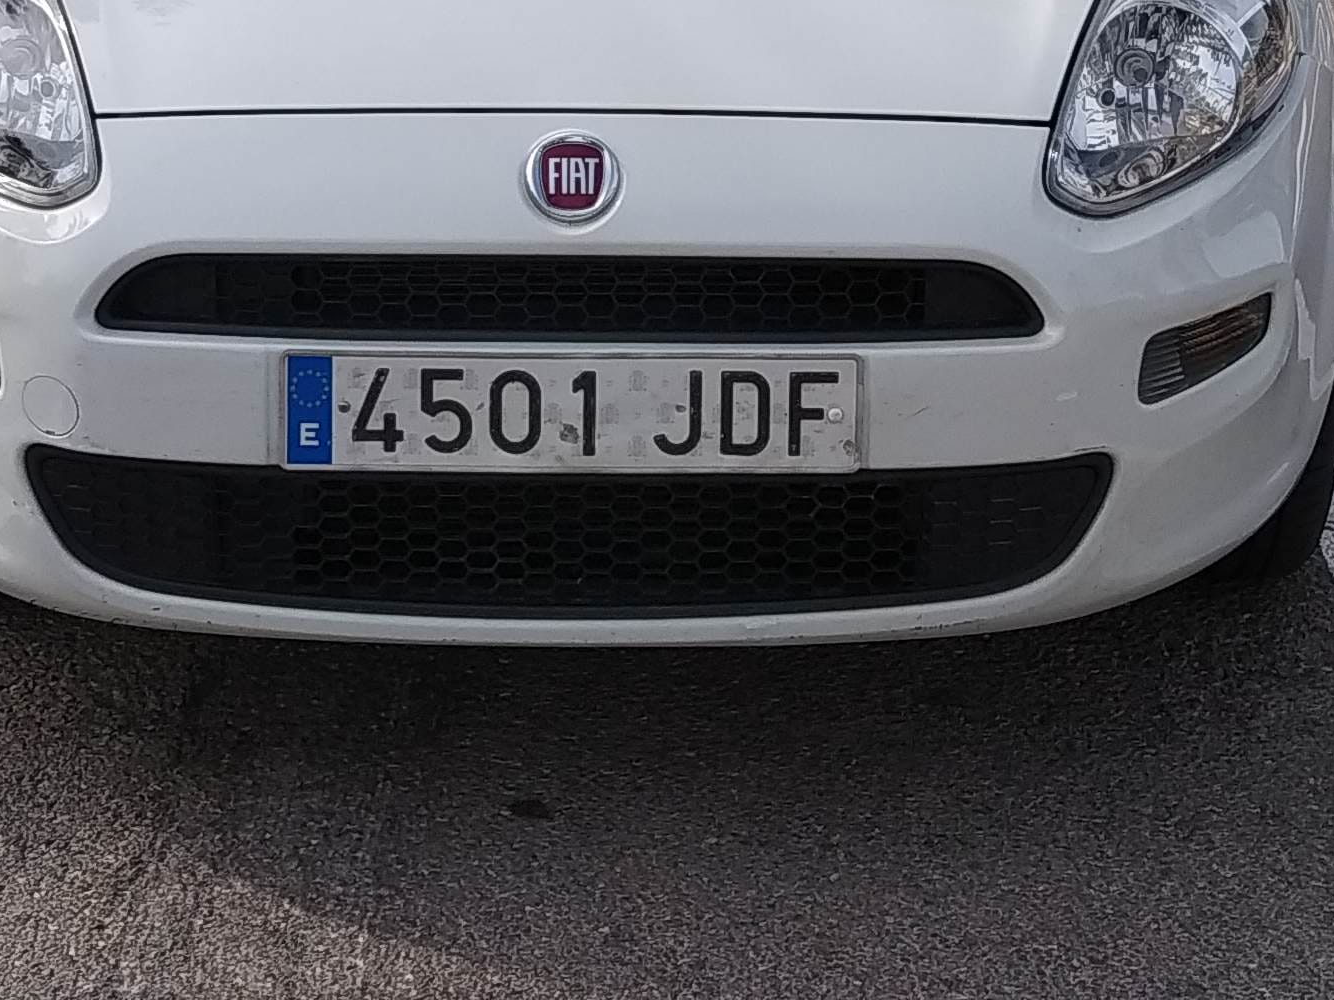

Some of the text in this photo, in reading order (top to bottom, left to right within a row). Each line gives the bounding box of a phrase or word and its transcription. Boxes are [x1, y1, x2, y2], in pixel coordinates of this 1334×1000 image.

[547, 157, 599, 195] FIAT
[351, 367, 840, 457] 4501 JDF
[299, 422, 320, 447] E
